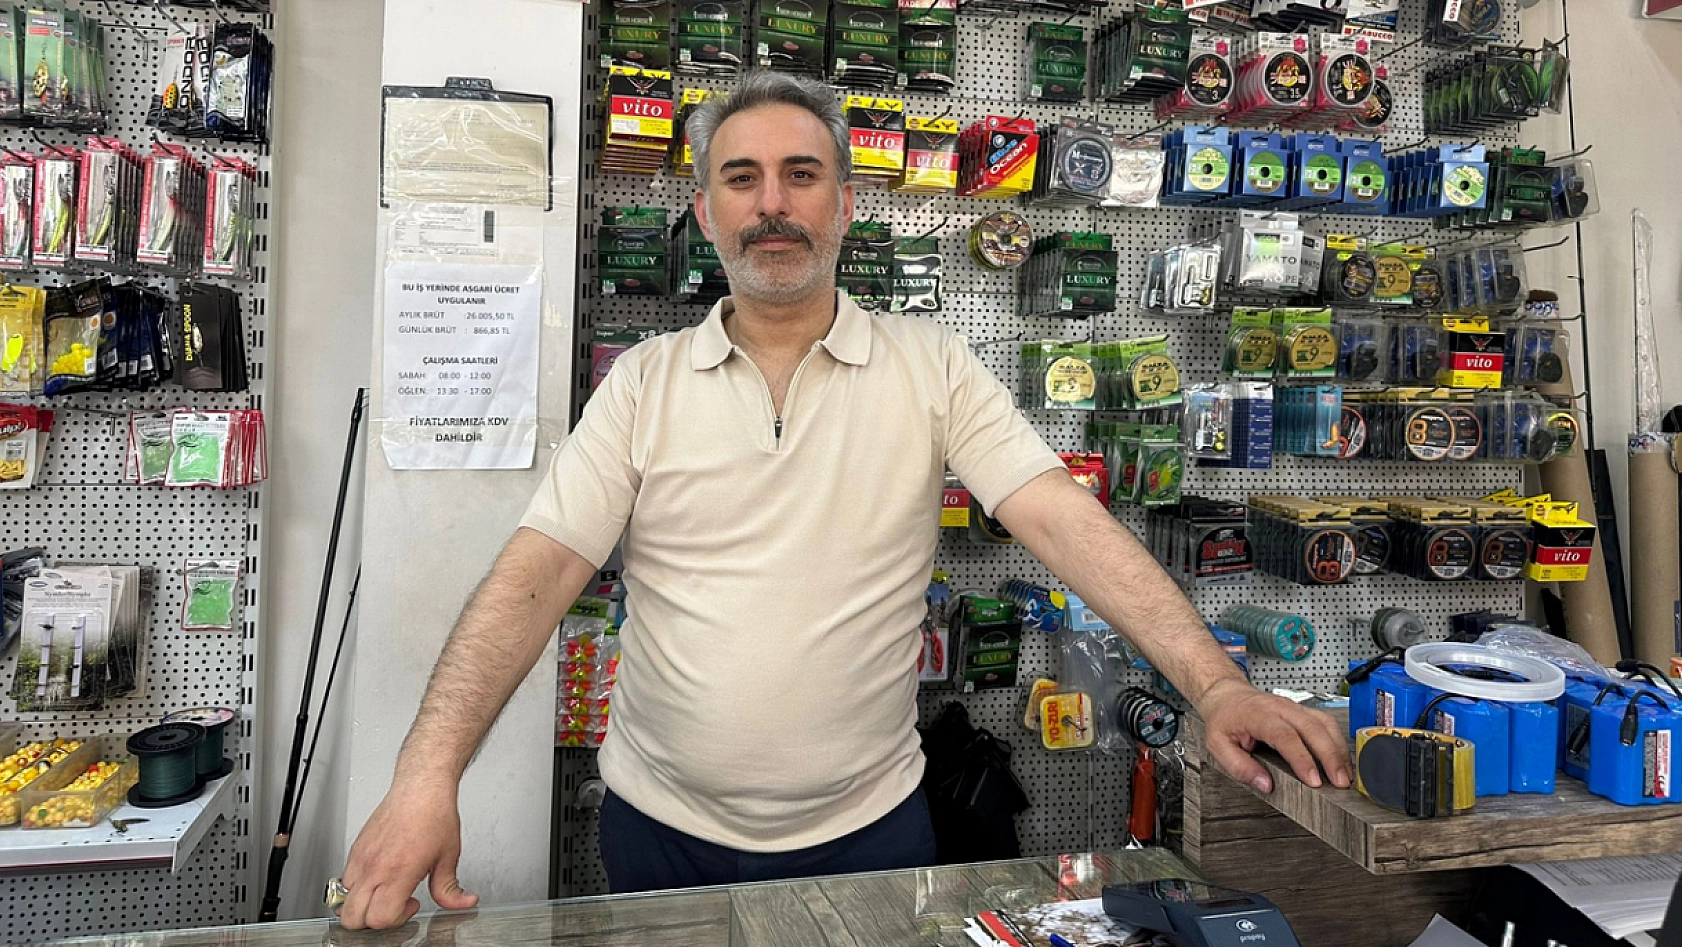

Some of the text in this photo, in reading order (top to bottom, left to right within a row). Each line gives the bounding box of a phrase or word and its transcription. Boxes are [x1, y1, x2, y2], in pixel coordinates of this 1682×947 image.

[686, 24, 735, 34] LUXURY
[767, 17, 818, 34] LUXURY
[608, 28, 661, 40] LUXURY
[842, 32, 891, 44] LUXURY
[904, 50, 949, 60] LUXURY
[1140, 45, 1184, 58] LUXURY
[1039, 63, 1080, 75] LUXURY
[622, 99, 663, 117] vito
[858, 131, 895, 148] vito
[916, 154, 949, 168] vito
[607, 256, 657, 266] LUXURY
[1246, 253, 1297, 265] YAMATO
[840, 264, 888, 274] LUXURY
[894, 278, 938, 288] LUXURY
[1066, 275, 1112, 285] LUXURY
[1387, 274, 1396, 288] 9
[416, 283, 424, 293] İŞ
[426, 283, 460, 293] YERİNDE
[462, 284, 493, 293] ASGARİ
[494, 284, 520, 294] ÜCRET
[437, 297, 486, 305] UYGULANIR
[398, 311, 421, 319] AYLIK
[423, 311, 445, 319] BRÜT
[507, 313, 515, 321] TL
[398, 325, 433, 334] GÜNLÜK
[434, 325, 457, 334] BRÜT
[473, 327, 500, 335] 866,85
[502, 327, 511, 335] TL
[1253, 347, 1263, 362] 9
[1309, 346, 1320, 362] 9
[422, 356, 498, 366] ÇALIŞMA SAATLERİ
[1466, 355, 1493, 369] vito
[469, 372, 491, 380] 12:00
[1152, 375, 1162, 391] 9
[470, 387, 492, 395] 17:00
[409, 415, 509, 426] FİYATLARIMIZA KDV
[435, 432, 483, 443] DAHİLDİR
[1409, 419, 1428, 444] 8
[1147, 470, 1160, 492] 9
[944, 493, 958, 505] to
[1554, 550, 1580, 562] vito
[973, 652, 1012, 664] LUXURY
